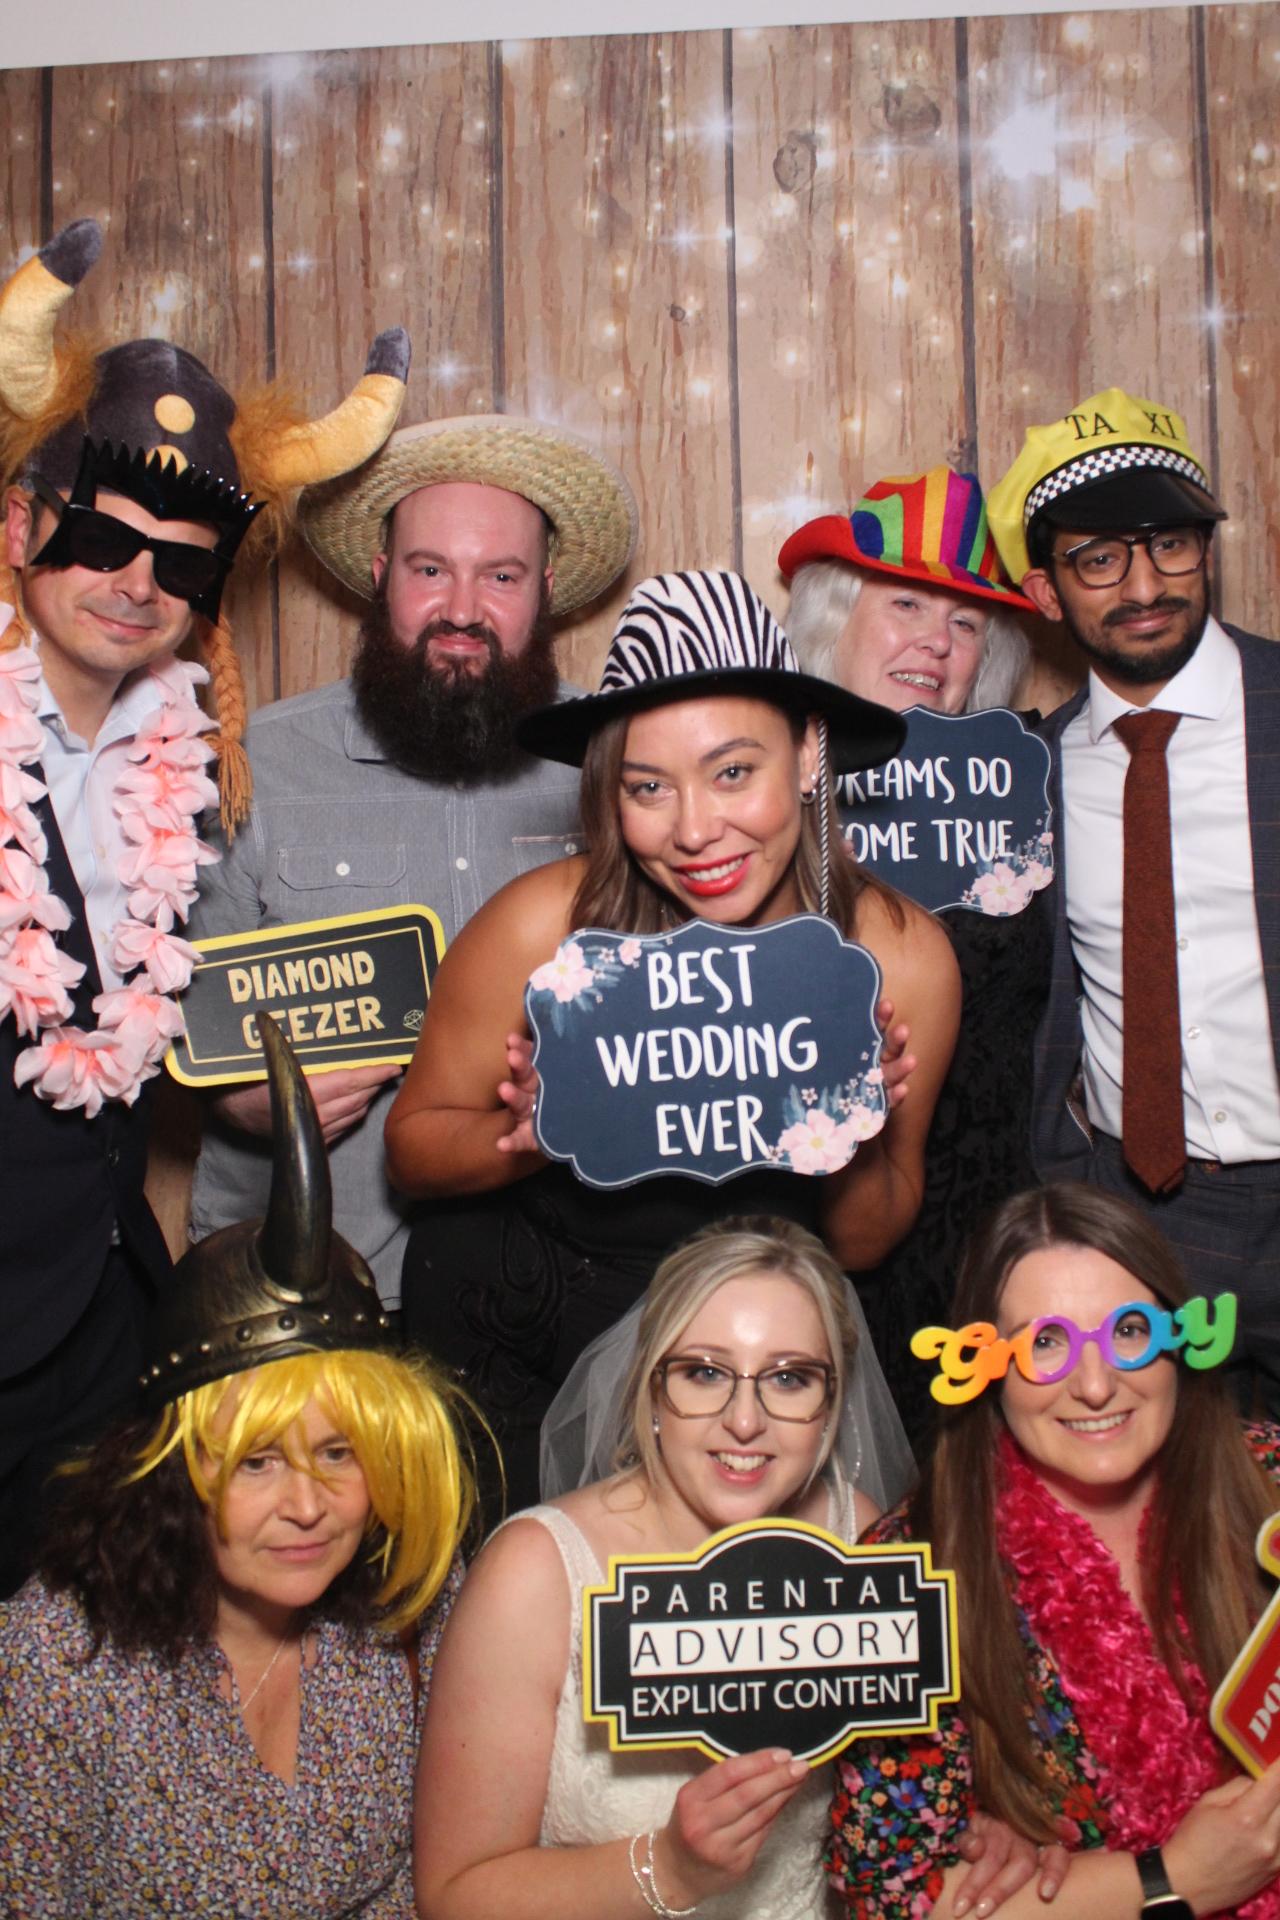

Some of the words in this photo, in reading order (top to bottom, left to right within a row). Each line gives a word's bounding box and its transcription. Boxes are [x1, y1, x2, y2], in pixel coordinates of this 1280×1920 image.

[967, 757, 1012, 798] DO
[837, 818, 919, 864] OME
[930, 818, 1015, 867] TRUE
[227, 951, 376, 1004] DIAMOND
[647, 944, 757, 1014] BEST
[595, 1016, 819, 1088] WEDDING
[656, 1095, 771, 1162] EVER
[631, 1574, 916, 1615] PARENTAL
[632, 1617, 917, 1669] ADVISORY
[632, 1681, 767, 1718] EXPLICIT
[773, 1672, 920, 1710] CONTENT
[1248, 1666, 1280, 1743] DO
